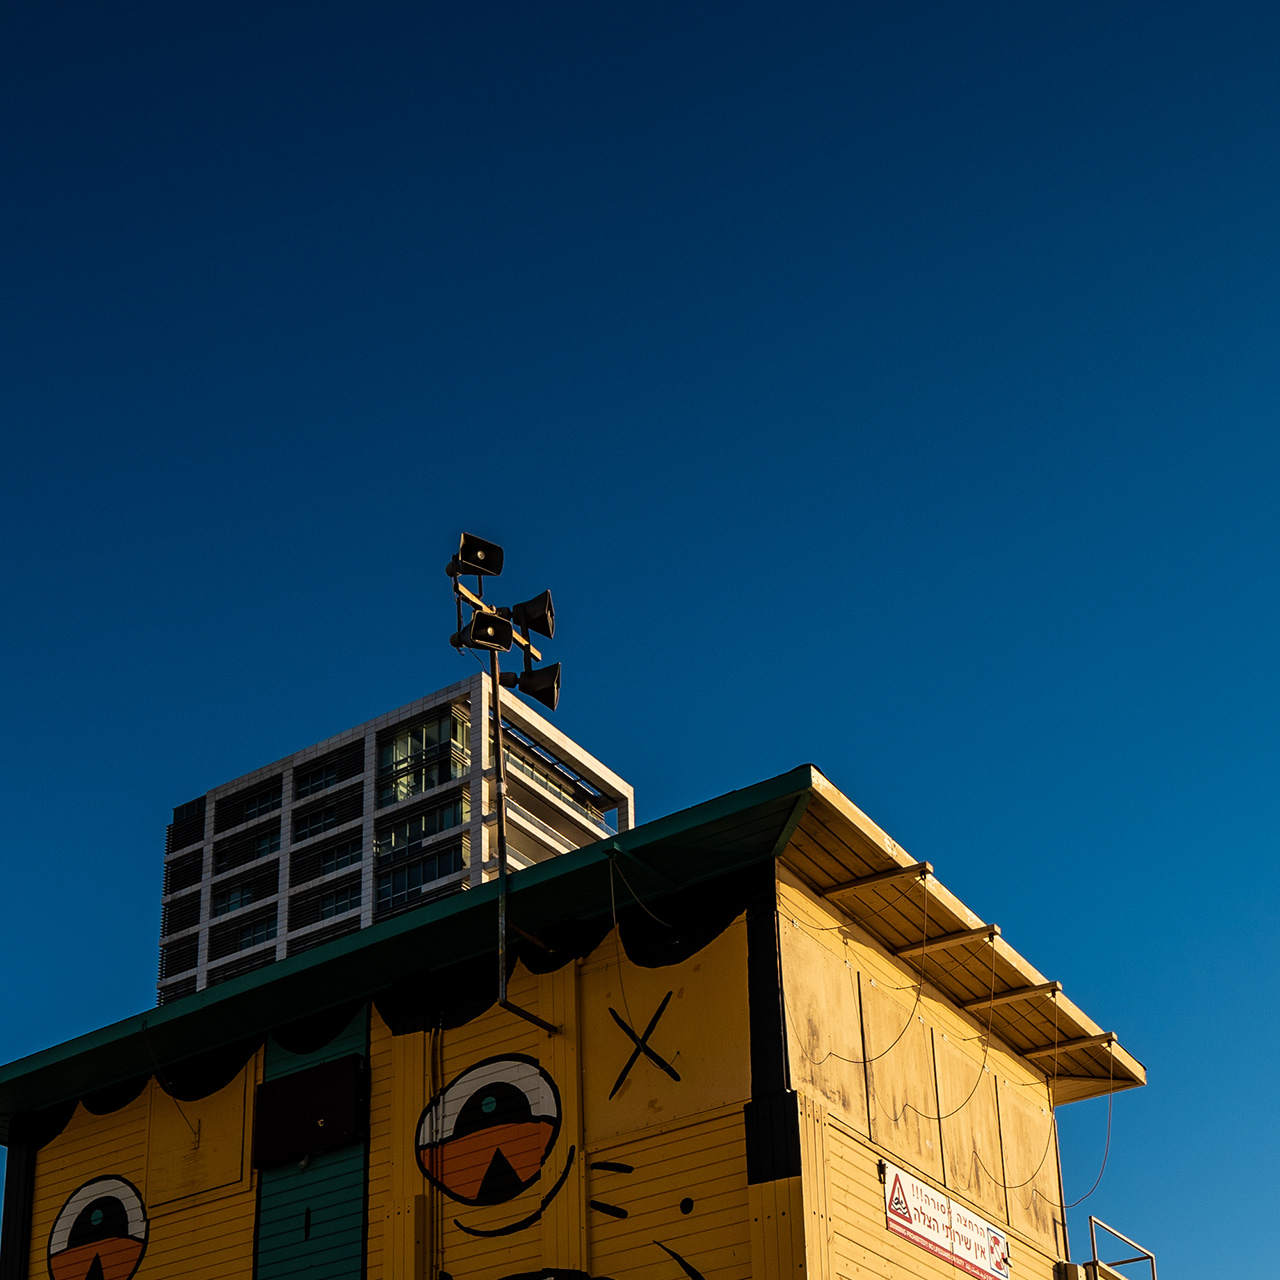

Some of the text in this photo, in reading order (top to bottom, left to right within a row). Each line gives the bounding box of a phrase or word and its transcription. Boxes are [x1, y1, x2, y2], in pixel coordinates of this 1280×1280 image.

[913, 1206, 939, 1233] הצלה
[956, 1212, 985, 1238] הרחצה
[942, 1223, 972, 1251] שירותי
[974, 1241, 986, 1260] אין
